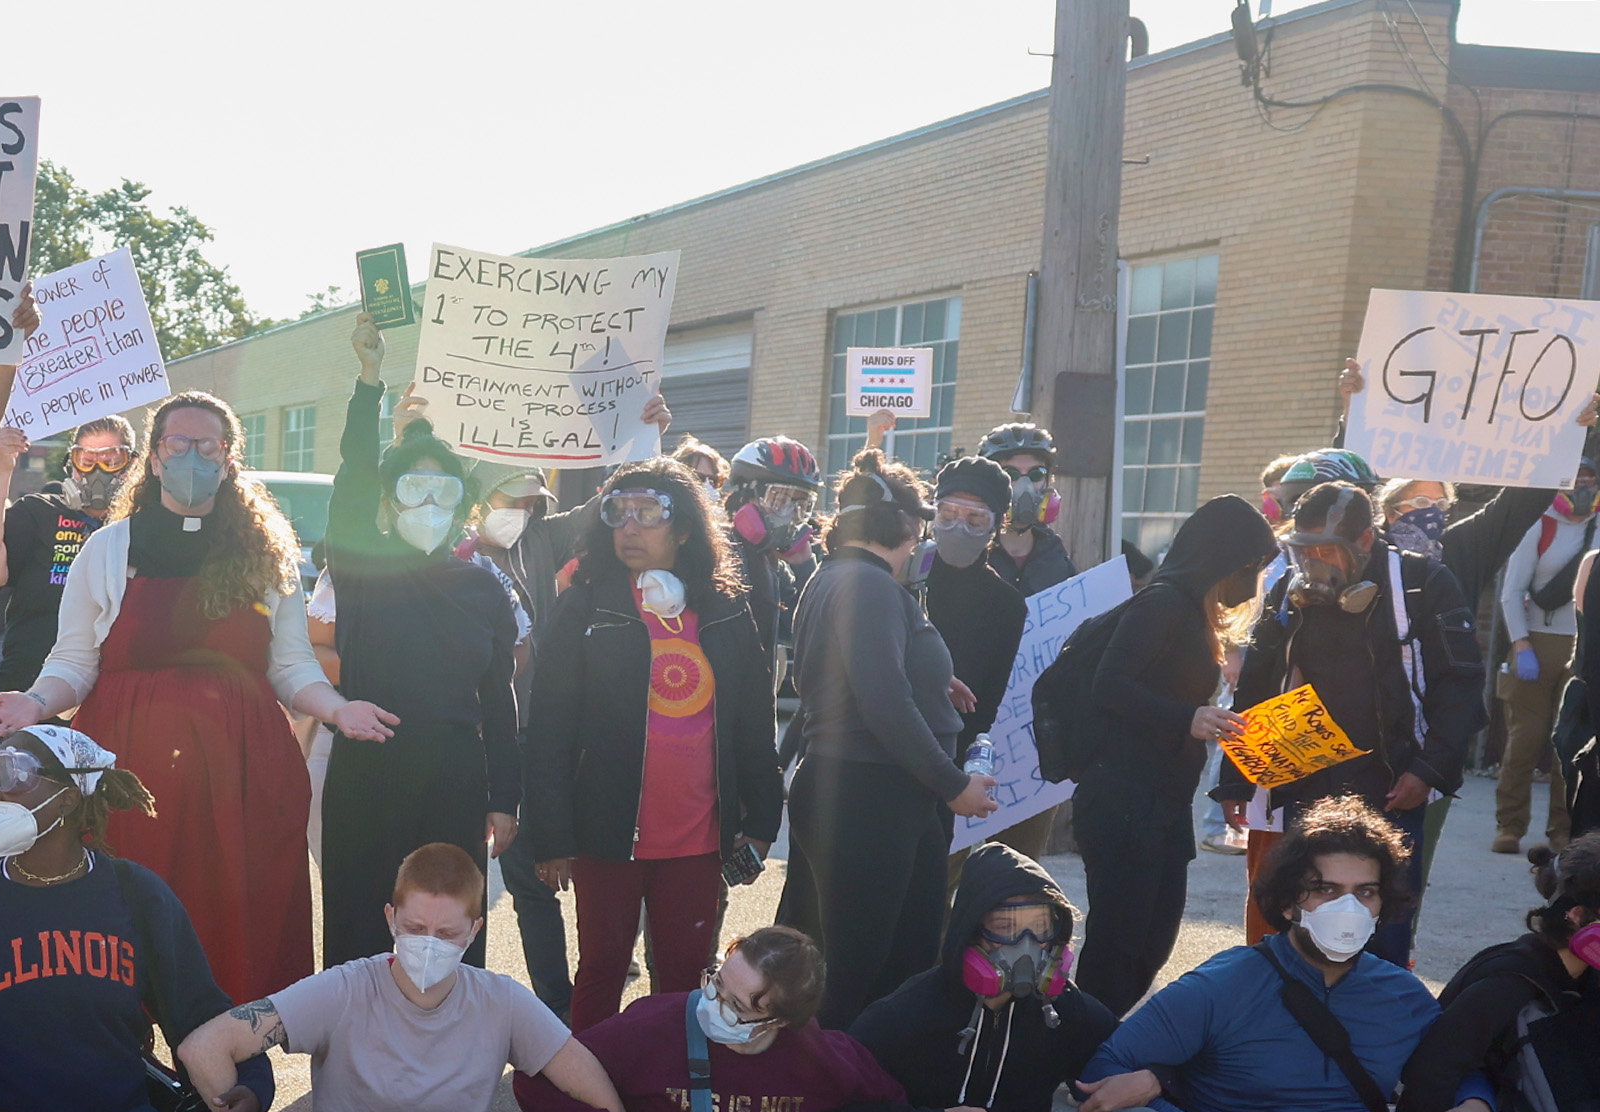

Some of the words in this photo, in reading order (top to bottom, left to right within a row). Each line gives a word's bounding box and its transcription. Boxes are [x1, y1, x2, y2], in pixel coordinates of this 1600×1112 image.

[34, 277, 84, 304] ower
[92, 260, 111, 289] of
[434, 250, 611, 295] EXERCISING
[22, 332, 50, 358] he
[61, 298, 125, 348] people
[473, 305, 508, 327] TO
[522, 307, 645, 334] PROTECT
[25, 345, 98, 390] greater
[105, 328, 144, 356] than
[472, 336, 534, 359] THE
[861, 355, 894, 366] HANDS
[896, 356, 915, 366] OFF
[423, 367, 569, 398] DETAINMENT
[582, 370, 655, 398] WITHOUT
[1382, 326, 1577, 424] GTFO
[3, 408, 34, 429] the
[41, 387, 93, 425] people
[98, 381, 114, 401] in
[119, 363, 163, 400] power
[457, 394, 506, 411] DUE
[522, 400, 616, 417] PROCESS
[860, 395, 913, 408] CHICAGO
[459, 414, 619, 450] ILLEGAL!
[511, 417, 530, 430] IS
[58, 515, 85, 528] lov
[1293, 733, 1321, 751] THE
